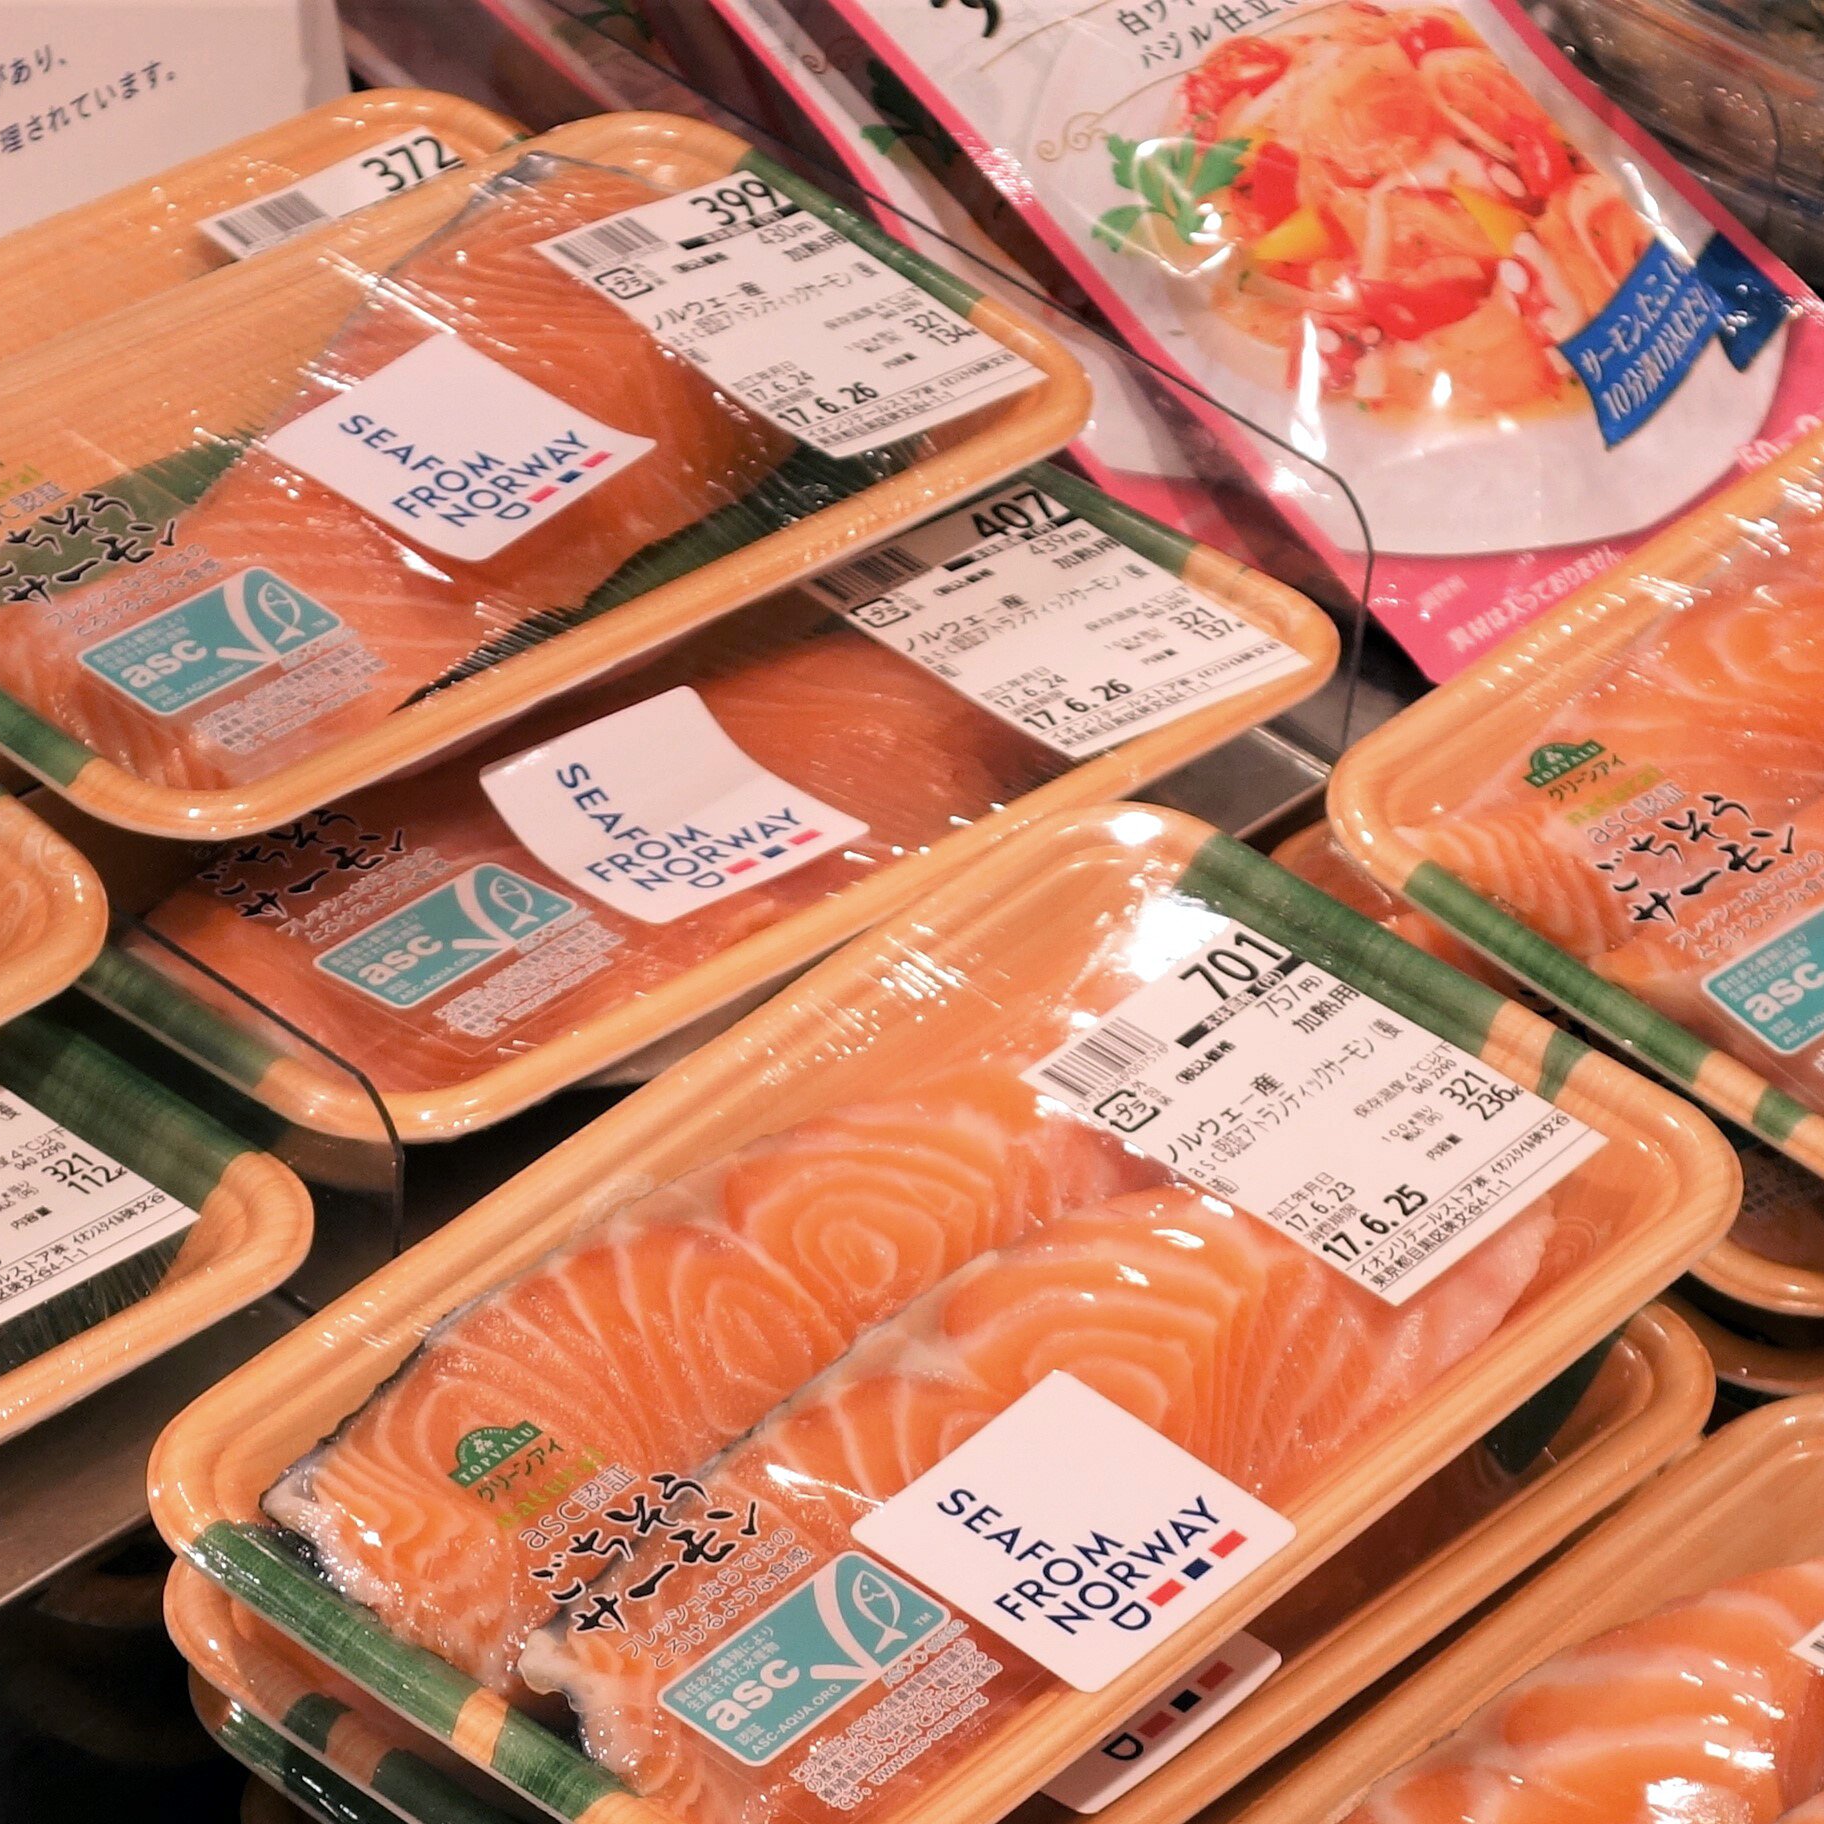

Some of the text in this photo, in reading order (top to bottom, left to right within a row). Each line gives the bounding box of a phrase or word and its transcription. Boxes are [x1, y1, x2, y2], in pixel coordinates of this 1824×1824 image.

[360, 133, 454, 193] 372
[690, 174, 778, 228] 399
[391, 448, 506, 522] FROM
[430, 428, 590, 529] NORWAY
[970, 487, 1054, 538] 407
[584, 823, 714, 887] FROM
[632, 806, 806, 890] NORWAY
[1180, 933, 1286, 1002] 701
[1168, 1073, 1283, 1163] ノルウェー産
[457, 1427, 534, 1485] TOPVALU
[531, 1472, 709, 1604] ごちそう
[575, 1500, 759, 1635] サーモン
[1043, 1495, 1223, 1638] NORWAY
[992, 1529, 1125, 1625] FROM
[705, 1658, 801, 1730] asc
